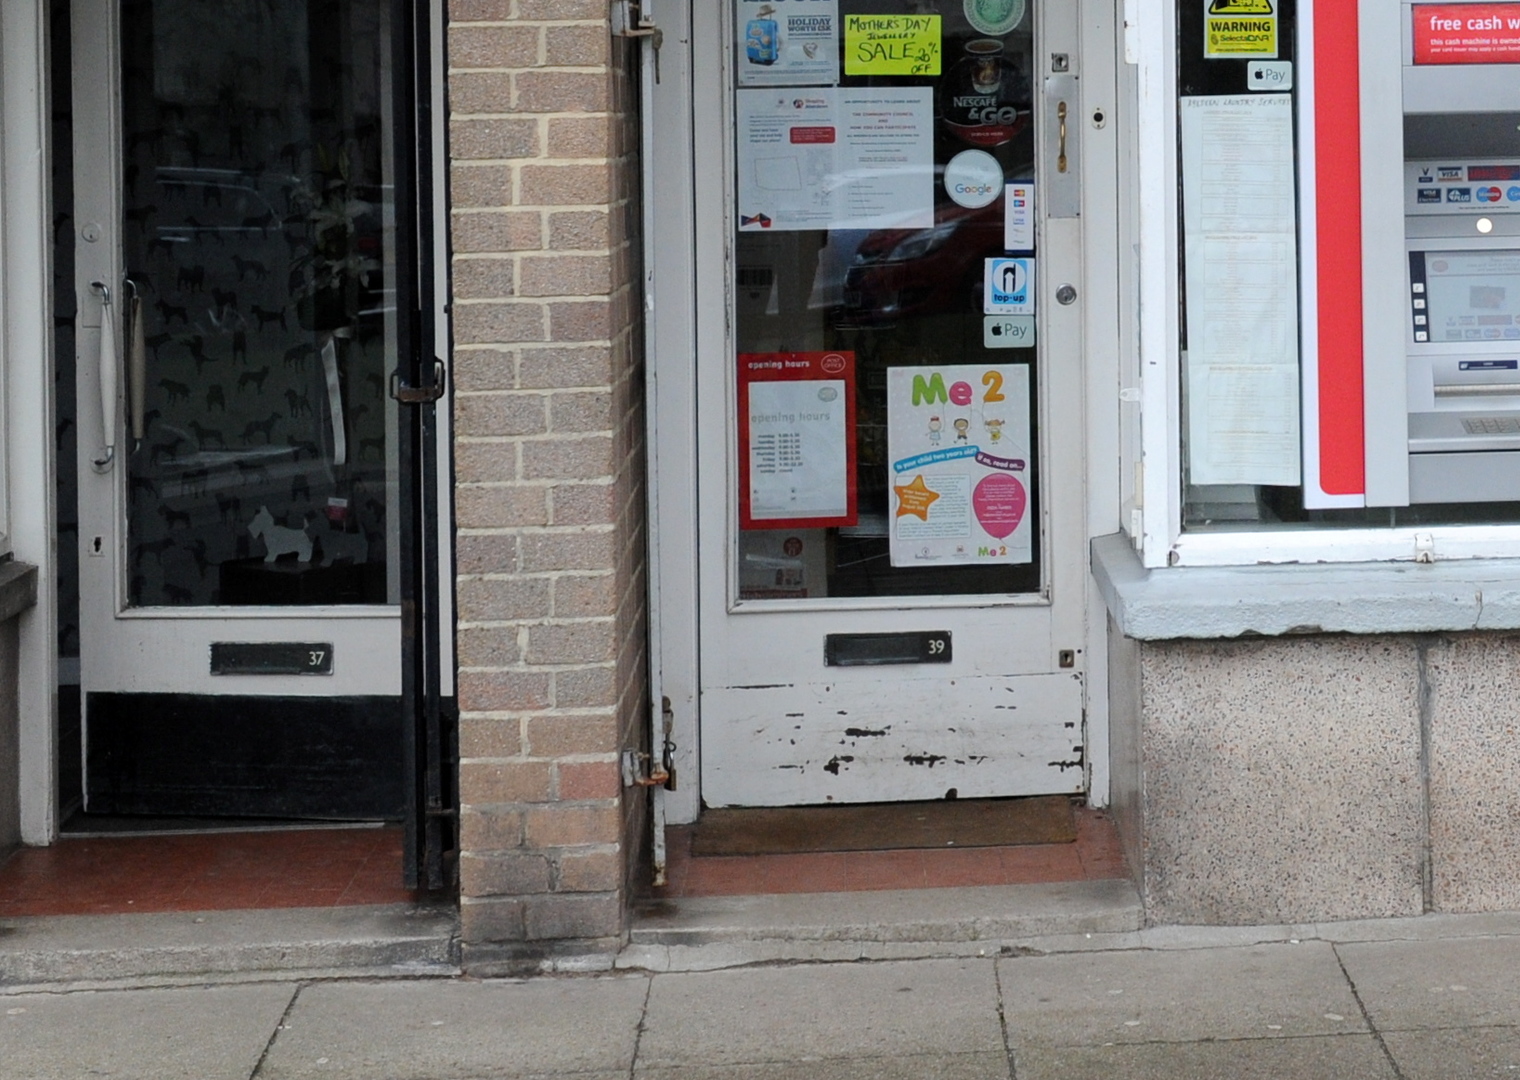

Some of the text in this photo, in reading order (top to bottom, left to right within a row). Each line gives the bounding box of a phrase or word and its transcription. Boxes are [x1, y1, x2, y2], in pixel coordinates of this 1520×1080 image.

[787, 18, 832, 26] HOLIDAY
[902, 17, 931, 32] DAY
[1210, 21, 1271, 32] WARNING
[1430, 15, 1462, 31] free
[1466, 14, 1502, 31] cash
[858, 41, 917, 63] SALE
[911, 63, 932, 74] OFF
[1265, 68, 1286, 82] Pay
[953, 95, 997, 108] NESCAFÉ
[955, 183, 992, 196] Google
[1454, 193, 1470, 201] PLUS
[994, 293, 1026, 304] top-up
[1004, 323, 1027, 339] Pay
[748, 360, 810, 370] opening hours
[911, 370, 1005, 406] Me 2
[751, 412, 831, 424] opening hours
[903, 461, 917, 469] your
[917, 455, 932, 464] child
[946, 451, 963, 459] years
[963, 447, 977, 455] old?
[977, 545, 1007, 557] Me 2
[928, 640, 945, 654] 39
[308, 651, 324, 665] 37
